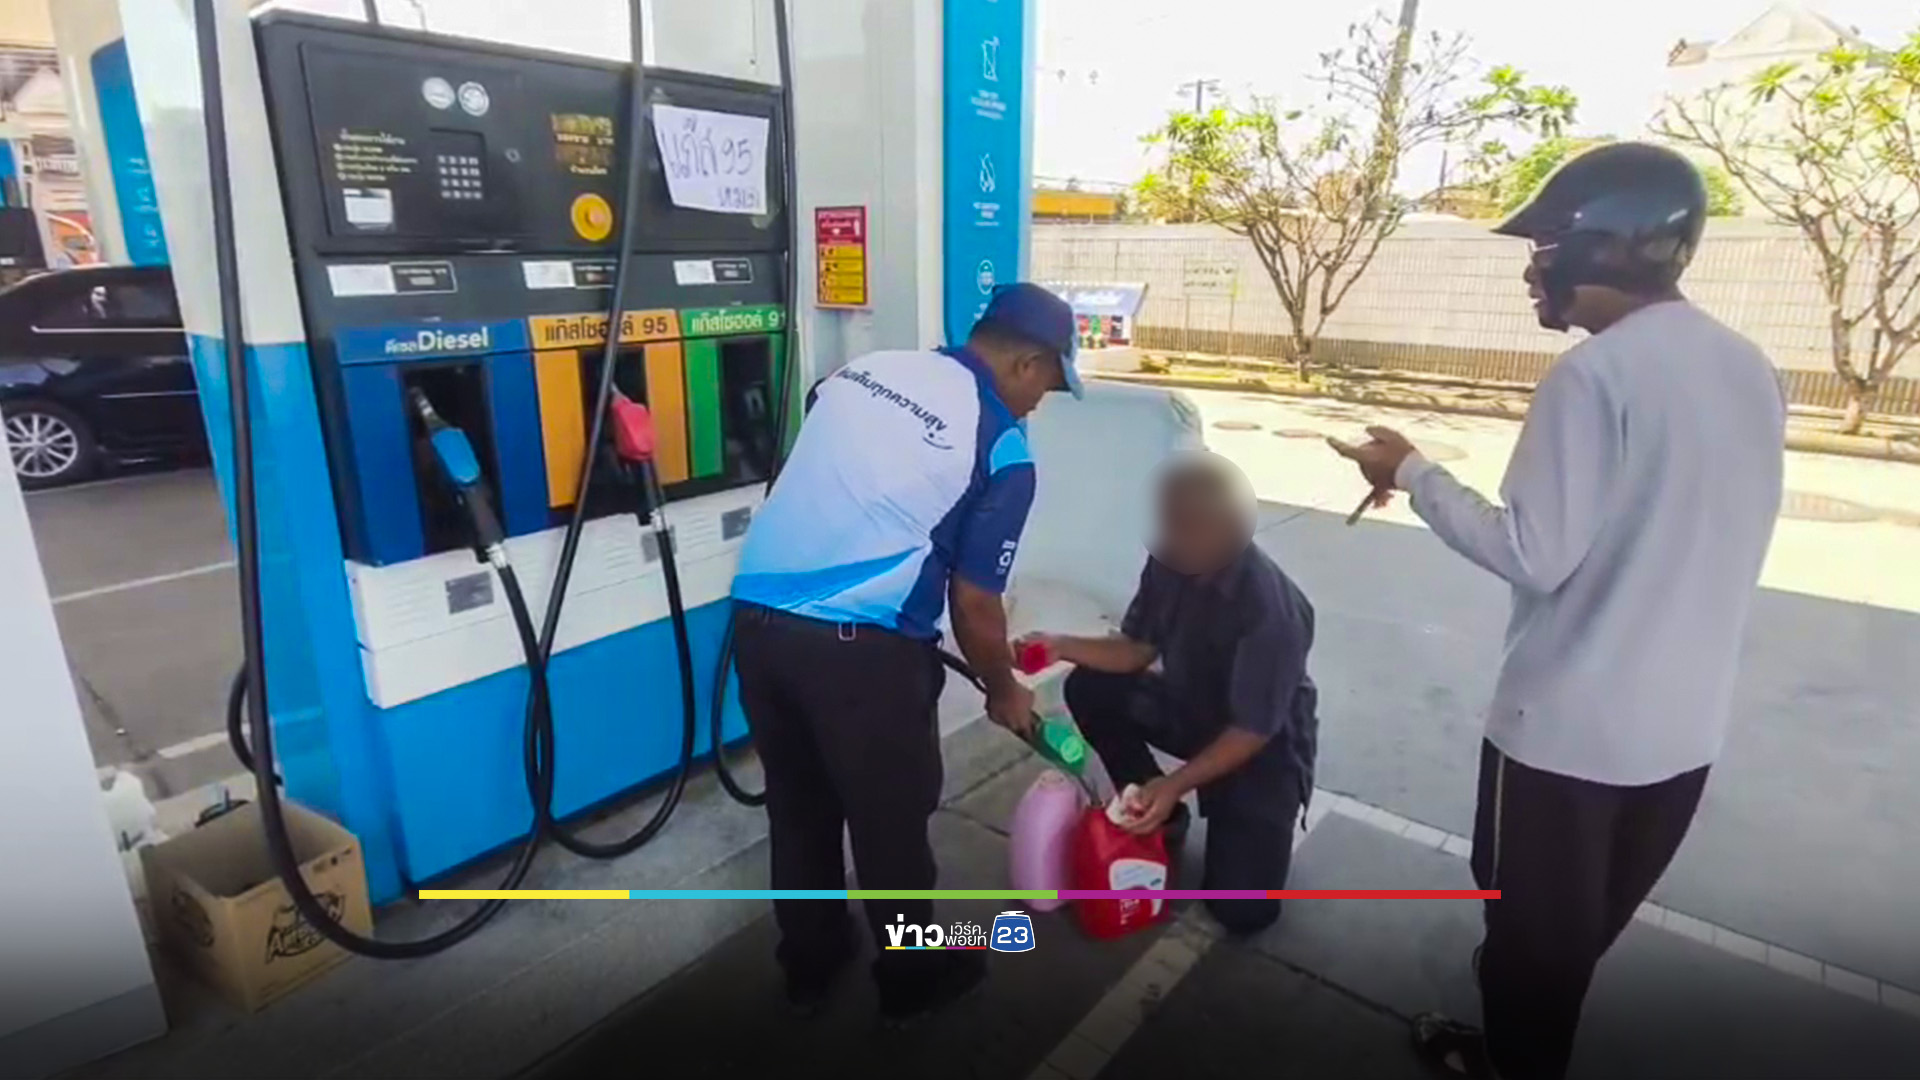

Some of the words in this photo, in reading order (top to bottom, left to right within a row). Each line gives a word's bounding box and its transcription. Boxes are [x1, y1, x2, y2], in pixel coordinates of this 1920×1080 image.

[722, 137, 753, 175] 95
[417, 326, 489, 351] Diesel
[545, 315, 634, 341] แก๊สโซฮล์
[643, 316, 668, 335] 95
